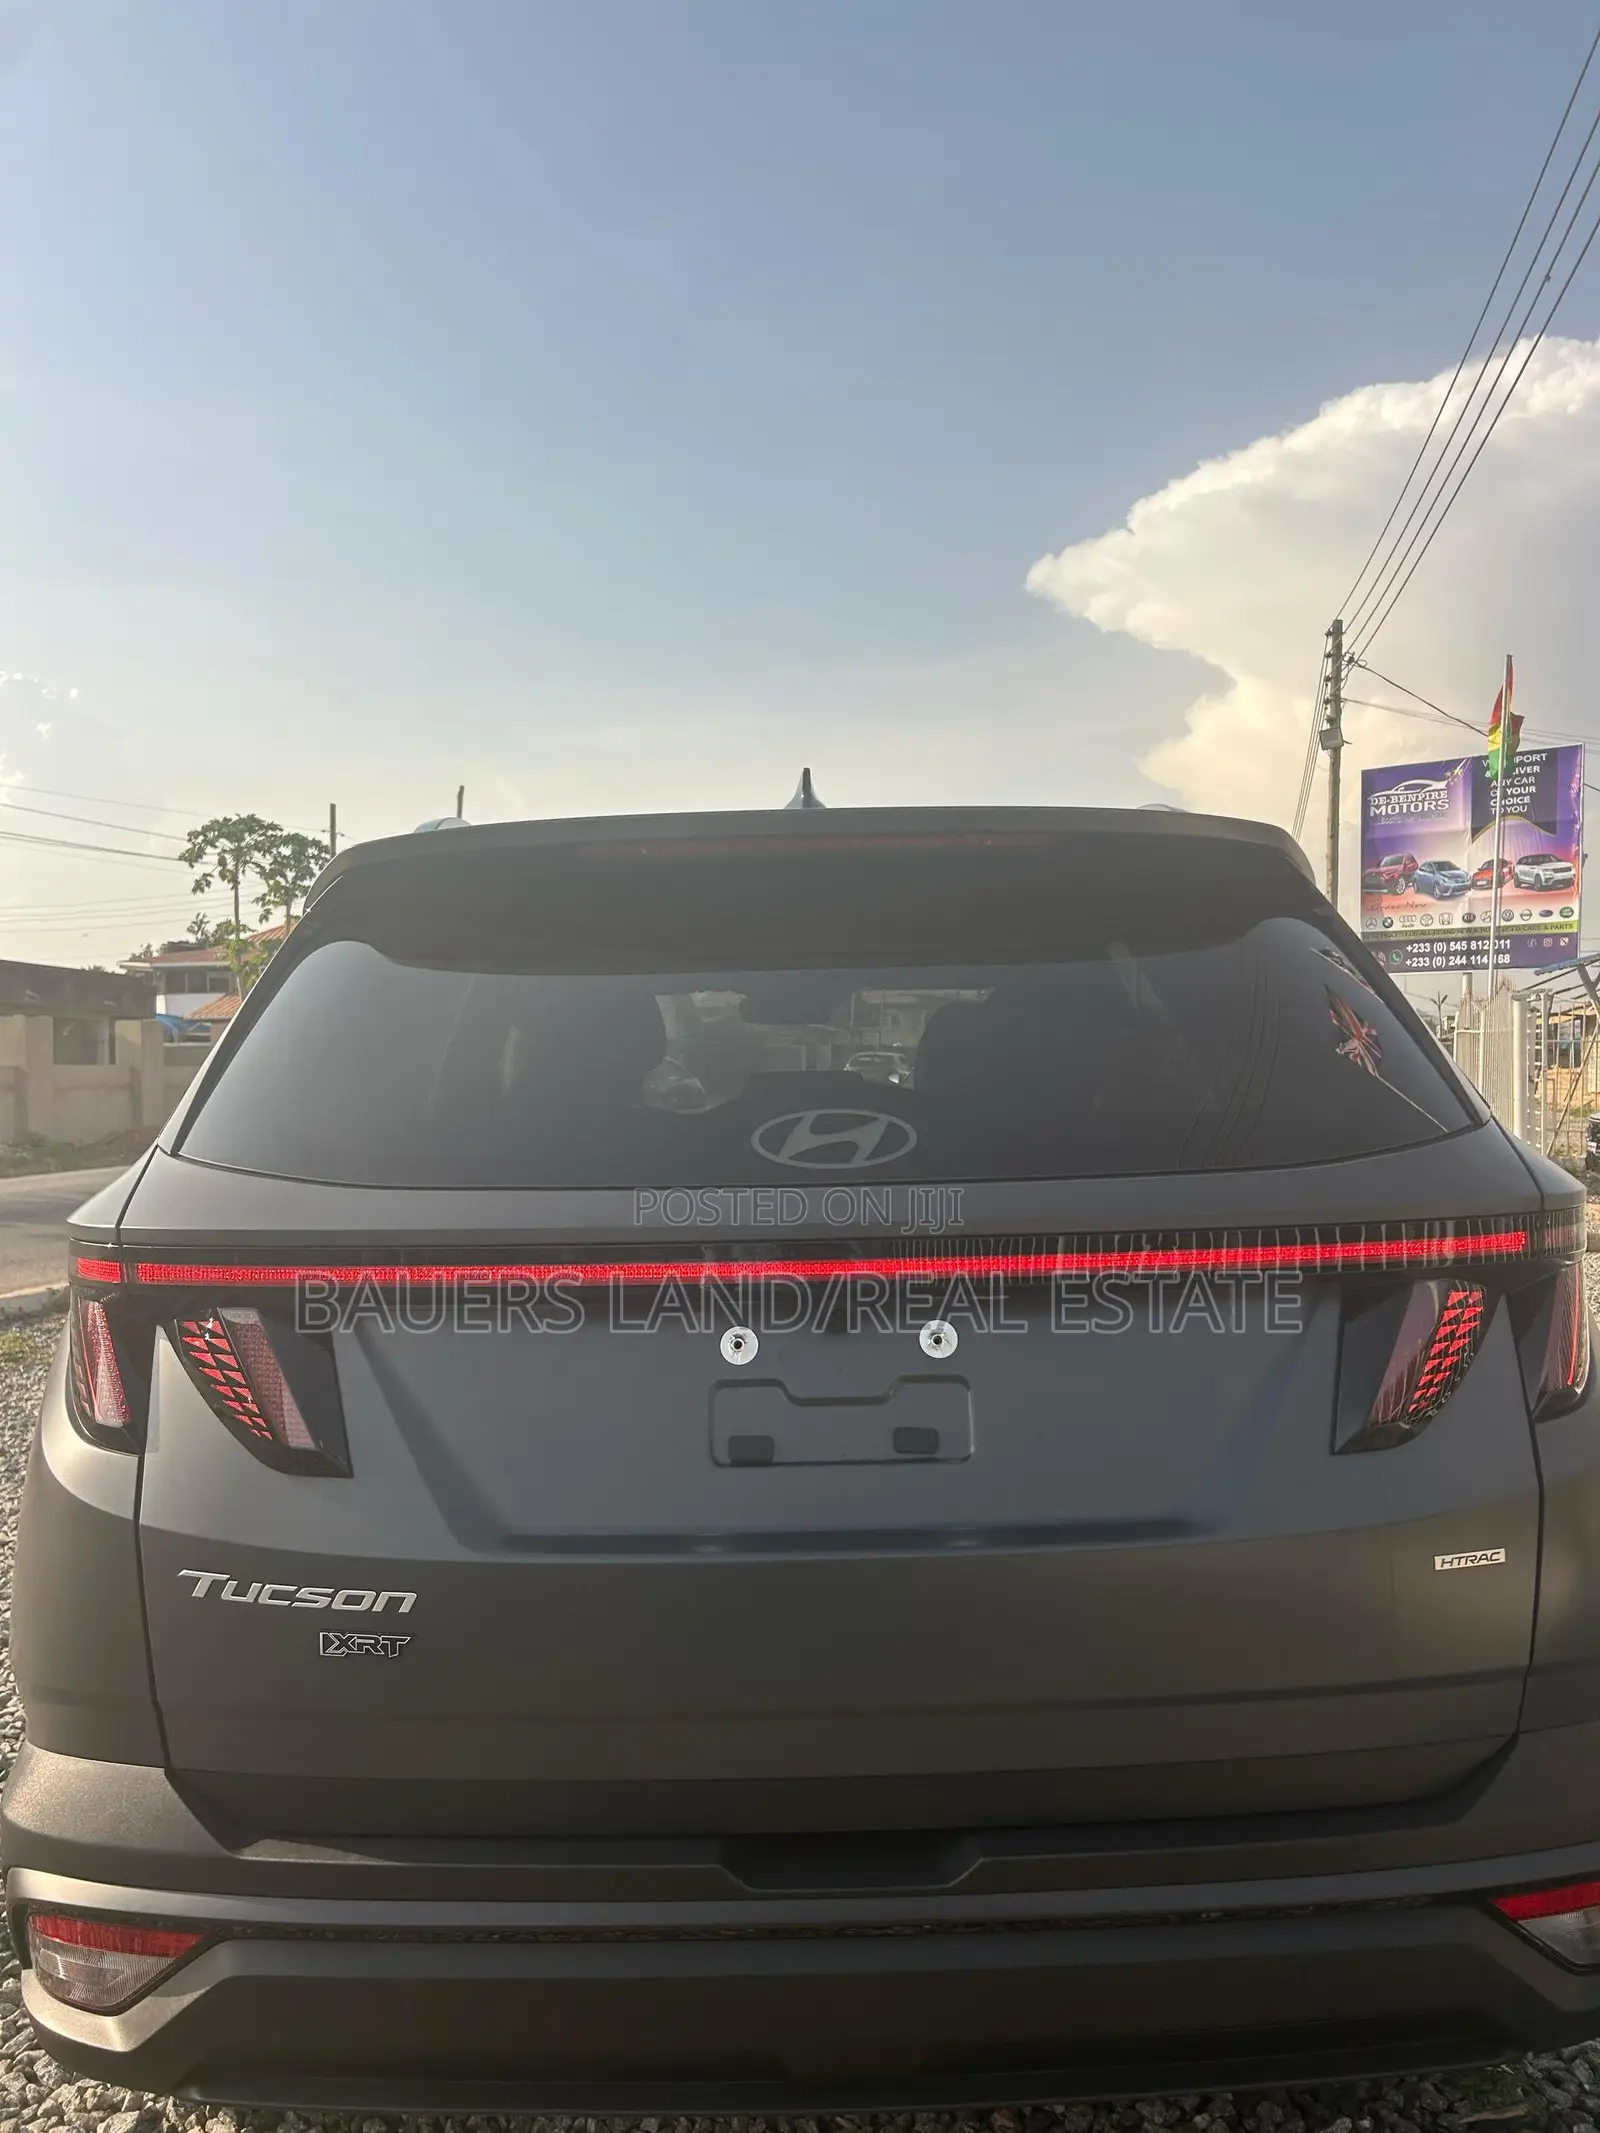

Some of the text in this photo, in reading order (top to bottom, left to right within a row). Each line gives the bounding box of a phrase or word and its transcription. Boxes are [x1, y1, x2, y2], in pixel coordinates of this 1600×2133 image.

[1514, 776, 1535, 785] CAR
[1506, 785, 1536, 795] YOUR
[1370, 799, 1449, 816] MOTORS
[1506, 805, 1528, 813] YOU
[1406, 942, 1431, 953] +233
[1433, 942, 1447, 953] (0)
[1449, 941, 1467, 951] 545
[1405, 957, 1430, 967] +233
[1432, 956, 1446, 968] (0)
[1448, 955, 1467, 966] 244
[1441, 1552, 1500, 1568] HTRAC
